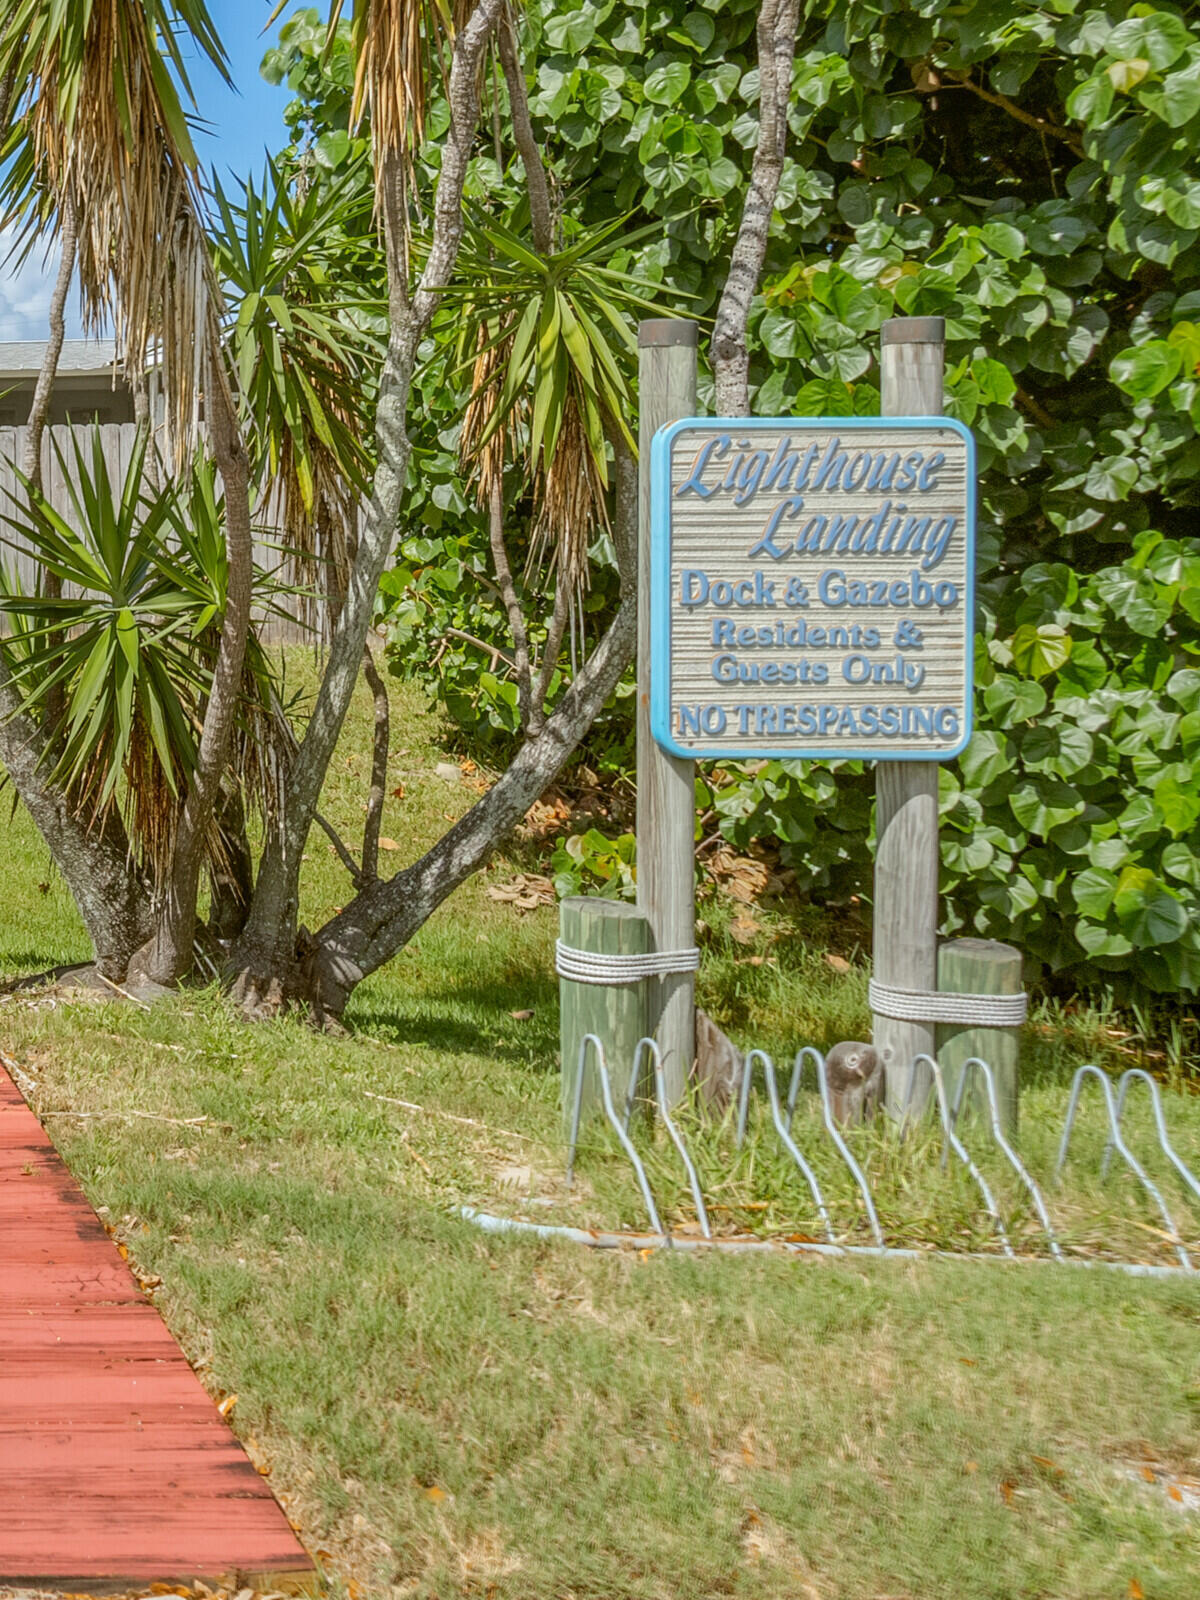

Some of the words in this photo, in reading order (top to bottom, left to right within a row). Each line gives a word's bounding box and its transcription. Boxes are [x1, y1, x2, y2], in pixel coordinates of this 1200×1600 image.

[675, 433, 946, 505] Lighthouse
[750, 495, 957, 569] Landing
[679, 568, 776, 606] Dock
[783, 575, 810, 607] &
[816, 568, 958, 607] Gazebo
[710, 616, 881, 648] Residents
[893, 618, 924, 648] &
[710, 653, 829, 683] Guests
[841, 653, 925, 688] Only
[678, 704, 727, 735] NO
[734, 704, 959, 736] TRESPASSING
